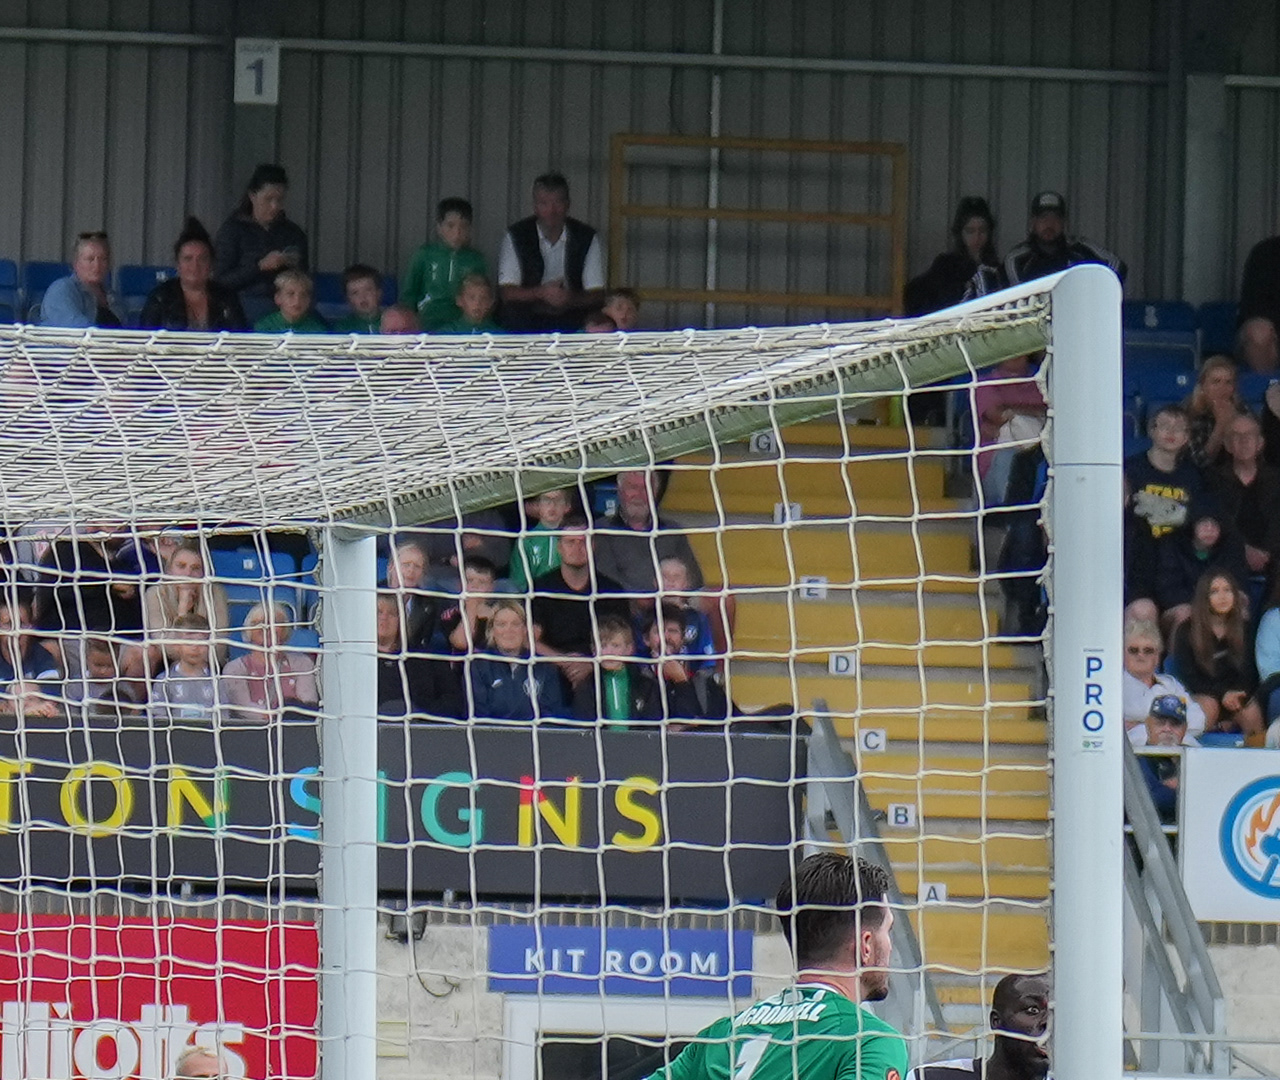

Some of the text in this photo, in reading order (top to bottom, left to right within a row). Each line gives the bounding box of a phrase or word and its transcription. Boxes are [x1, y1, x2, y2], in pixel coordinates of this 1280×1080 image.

[246, 57, 264, 95] 1
[835, 656, 850, 673] D
[1083, 657, 1104, 732] PRO
[864, 731, 880, 750] C
[894, 807, 908, 825] B
[925, 886, 942, 903] A
[525, 949, 719, 976] KIT ROOM
